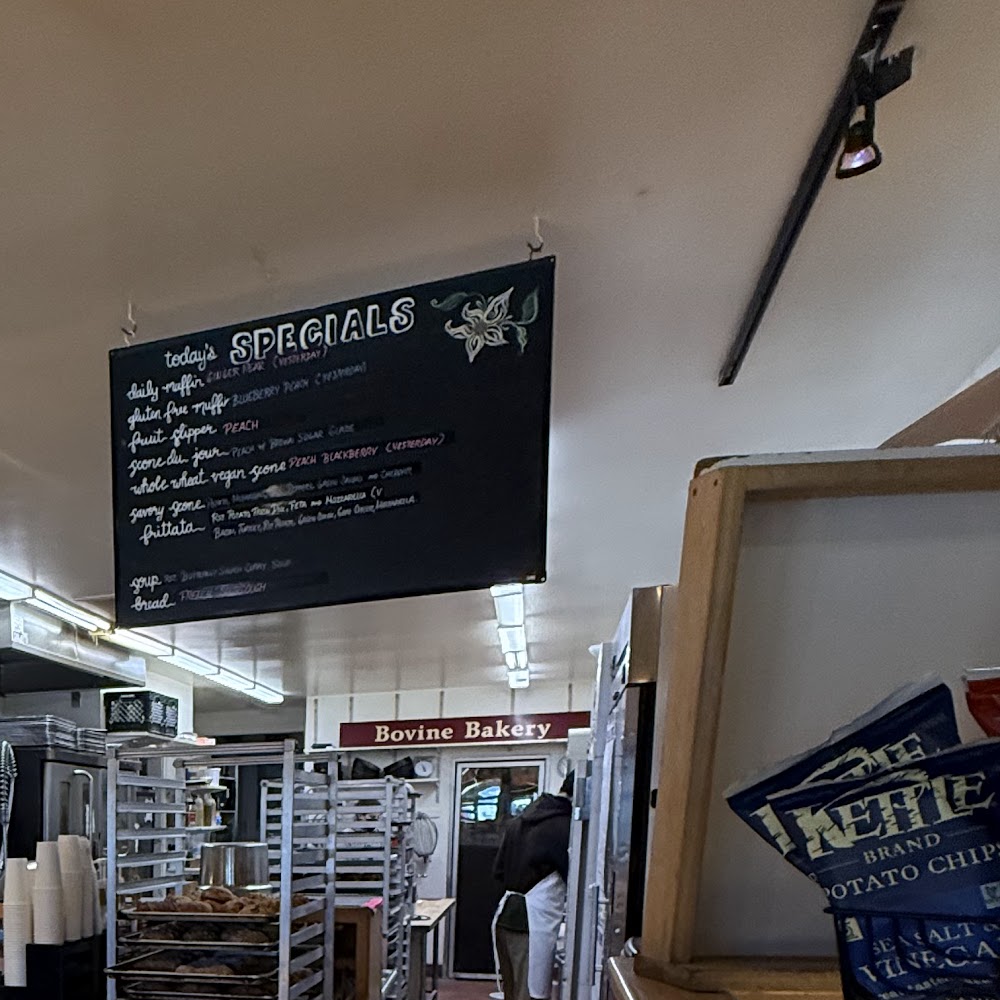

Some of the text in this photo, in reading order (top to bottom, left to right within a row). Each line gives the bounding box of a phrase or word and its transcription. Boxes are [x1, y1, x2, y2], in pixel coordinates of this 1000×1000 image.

[164, 297, 415, 371] today's SPECIALS
[126, 379, 159, 402] daily
[161, 373, 205, 397] muffin
[127, 405, 163, 430] gluten
[163, 400, 189, 424] free
[128, 419, 259, 453] fruit slipper PEACH
[127, 447, 230, 478] scone du jour
[130, 475, 169, 496] whole
[170, 468, 209, 490] wheat
[210, 468, 247, 489] vegan
[248, 461, 286, 483] scone
[322, 446, 378, 464] BLACKBERRY
[129, 499, 206, 525] savory scone
[139, 518, 206, 546] frittata
[129, 575, 162, 594] soup
[131, 593, 176, 611] bread
[374, 720, 551, 743] Bovine Bakery
[785, 768, 996, 861] KETTLE
[863, 833, 942, 865] BRAND
